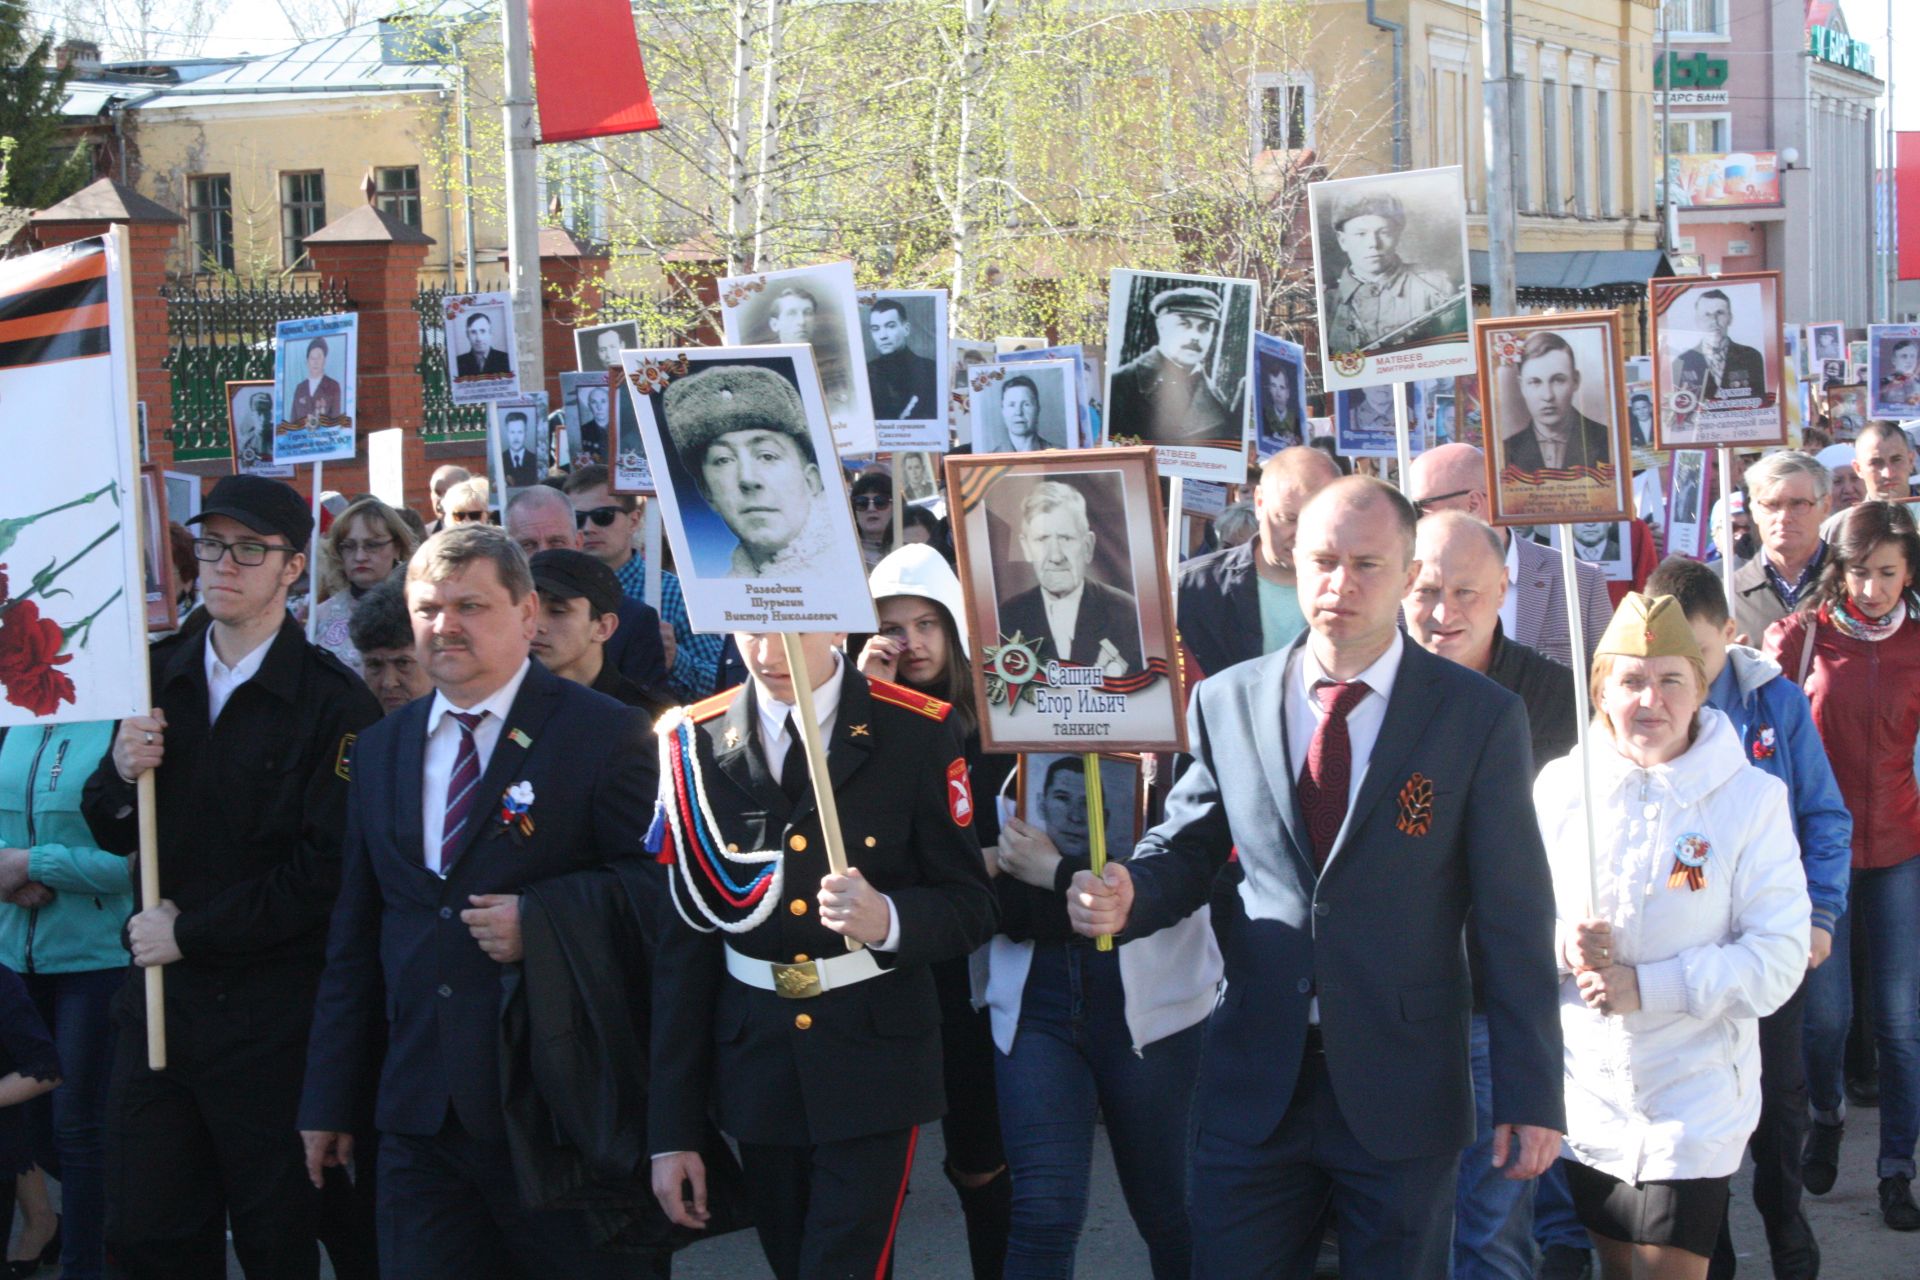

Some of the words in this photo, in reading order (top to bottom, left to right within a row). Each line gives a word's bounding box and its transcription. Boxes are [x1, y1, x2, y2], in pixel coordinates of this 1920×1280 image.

[1696, 93, 1726, 102] БАНК
[1376, 353, 1423, 365] МАТВЕЕВ
[1376, 363, 1415, 374] ДМИТРИЙ
[1417, 357, 1468, 369] ФЕДОРОВИЧ
[745, 583, 803, 594] Разведчик
[751, 597, 804, 610] Шурыгин
[724, 611, 768, 624] Виктор
[771, 611, 838, 621] Николаевич
[1047, 661, 1102, 686] Сашин
[1036, 689, 1073, 720] Егор
[1077, 689, 1126, 713] Ильич
[1053, 723, 1111, 735] танкист
